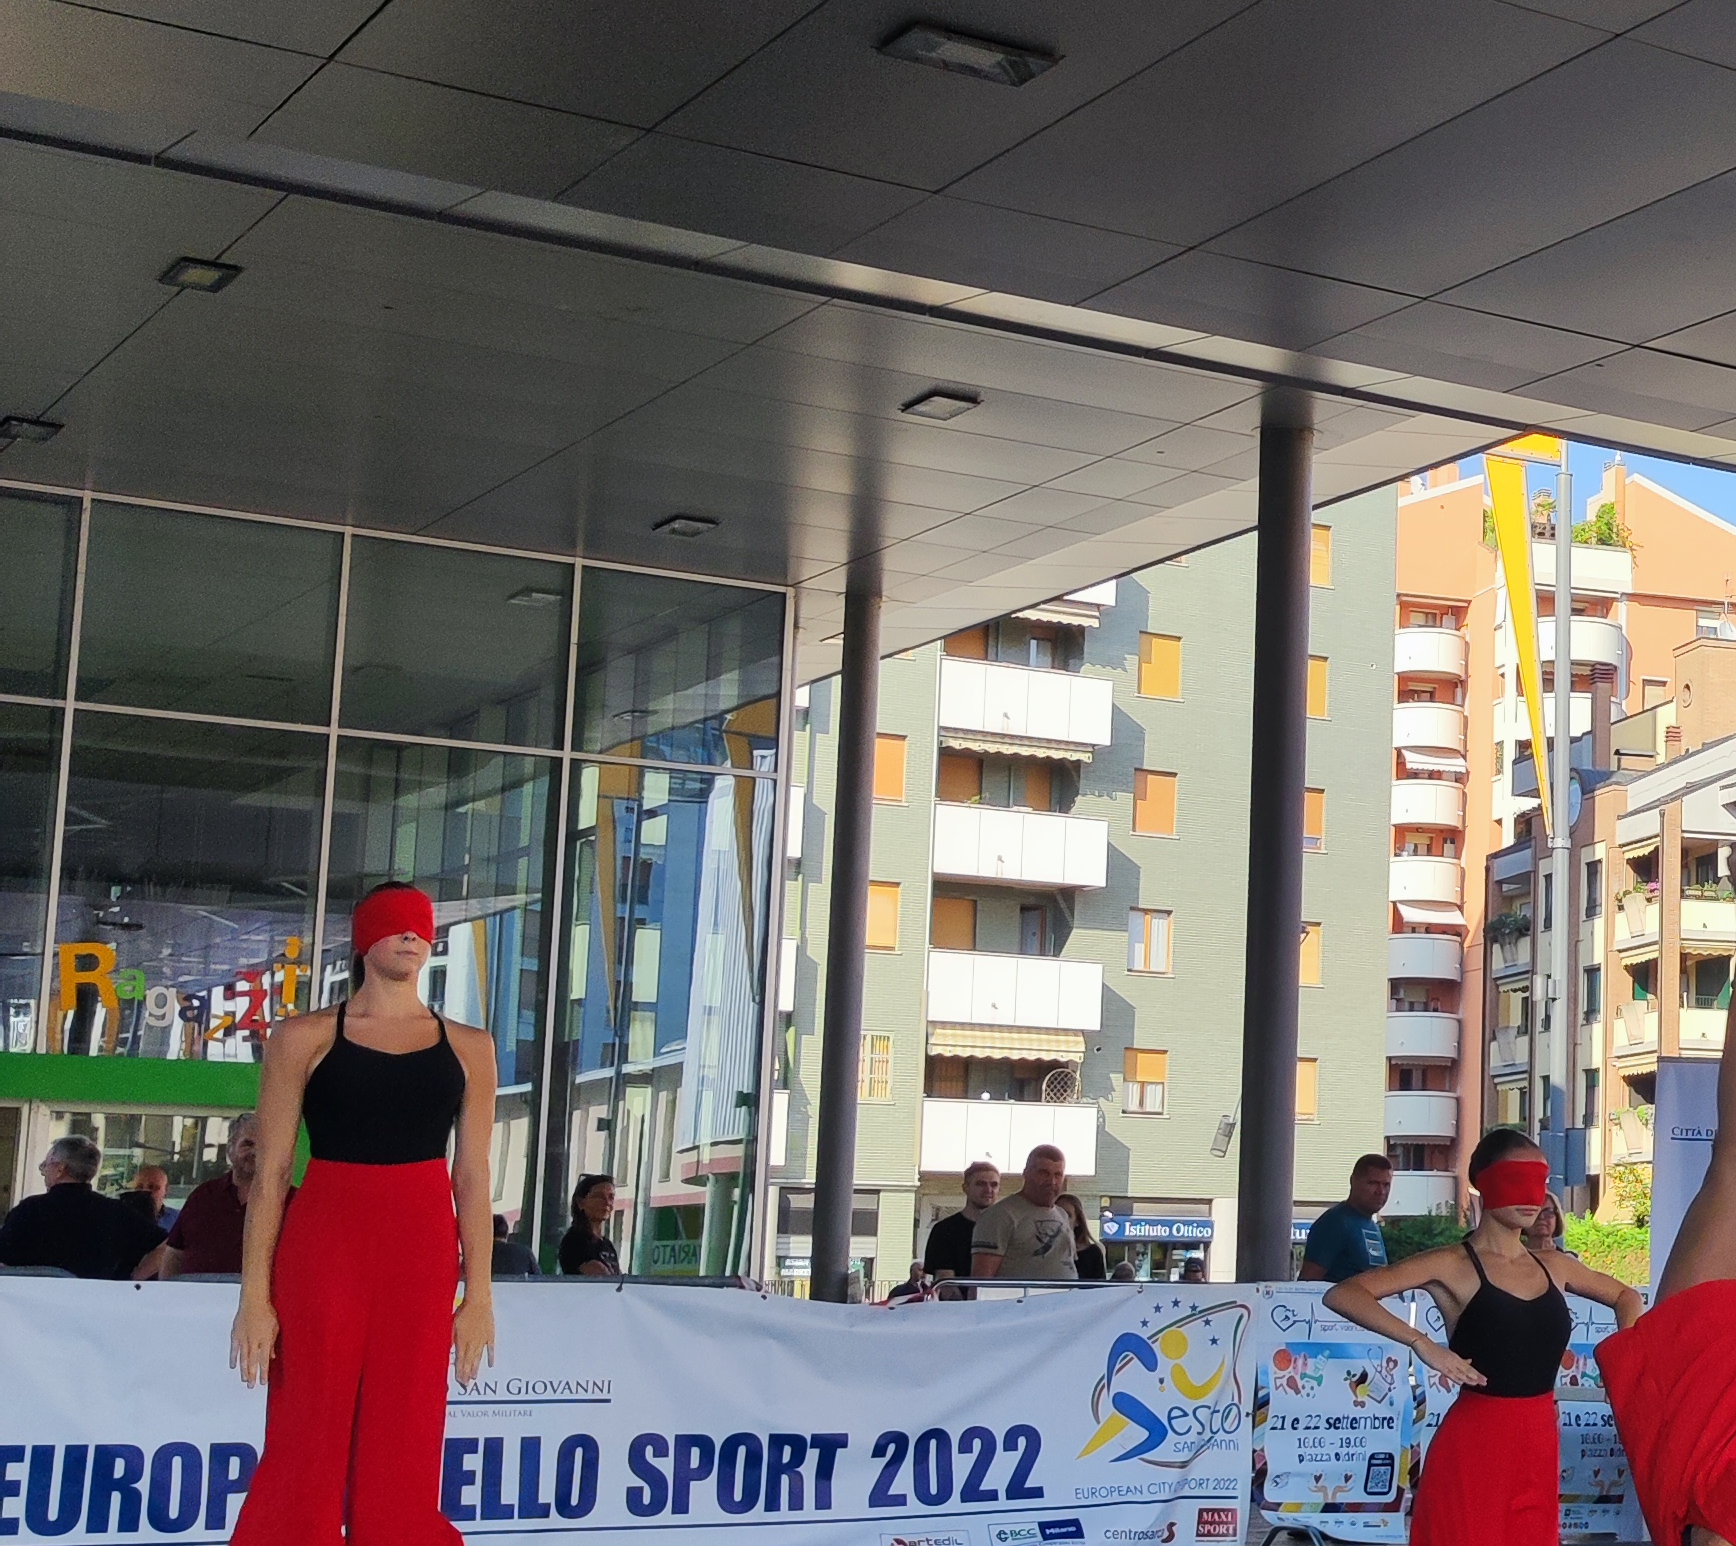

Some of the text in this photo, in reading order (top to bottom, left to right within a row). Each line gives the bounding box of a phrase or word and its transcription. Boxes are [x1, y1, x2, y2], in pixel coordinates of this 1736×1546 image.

[1124, 1221, 1212, 1238] Istituto Ottico
[506, 1378, 612, 1396] GIOVANNI
[461, 1410, 490, 1418] VALOR
[492, 1409, 533, 1418] MILITARE
[1583, 1411, 1598, 1427] 22
[1269, 1413, 1394, 1431] 21 e 22 settembre
[626, 1431, 849, 1518] SPORT
[868, 1423, 1045, 1509] 2022
[1074, 1483, 1143, 1500] EUROPEAN
[1212, 1477, 1239, 1491] 2022
[1202, 1511, 1232, 1522] MAXI
[1009, 1528, 1038, 1538] BCC
[1198, 1523, 1236, 1535] SPORT
